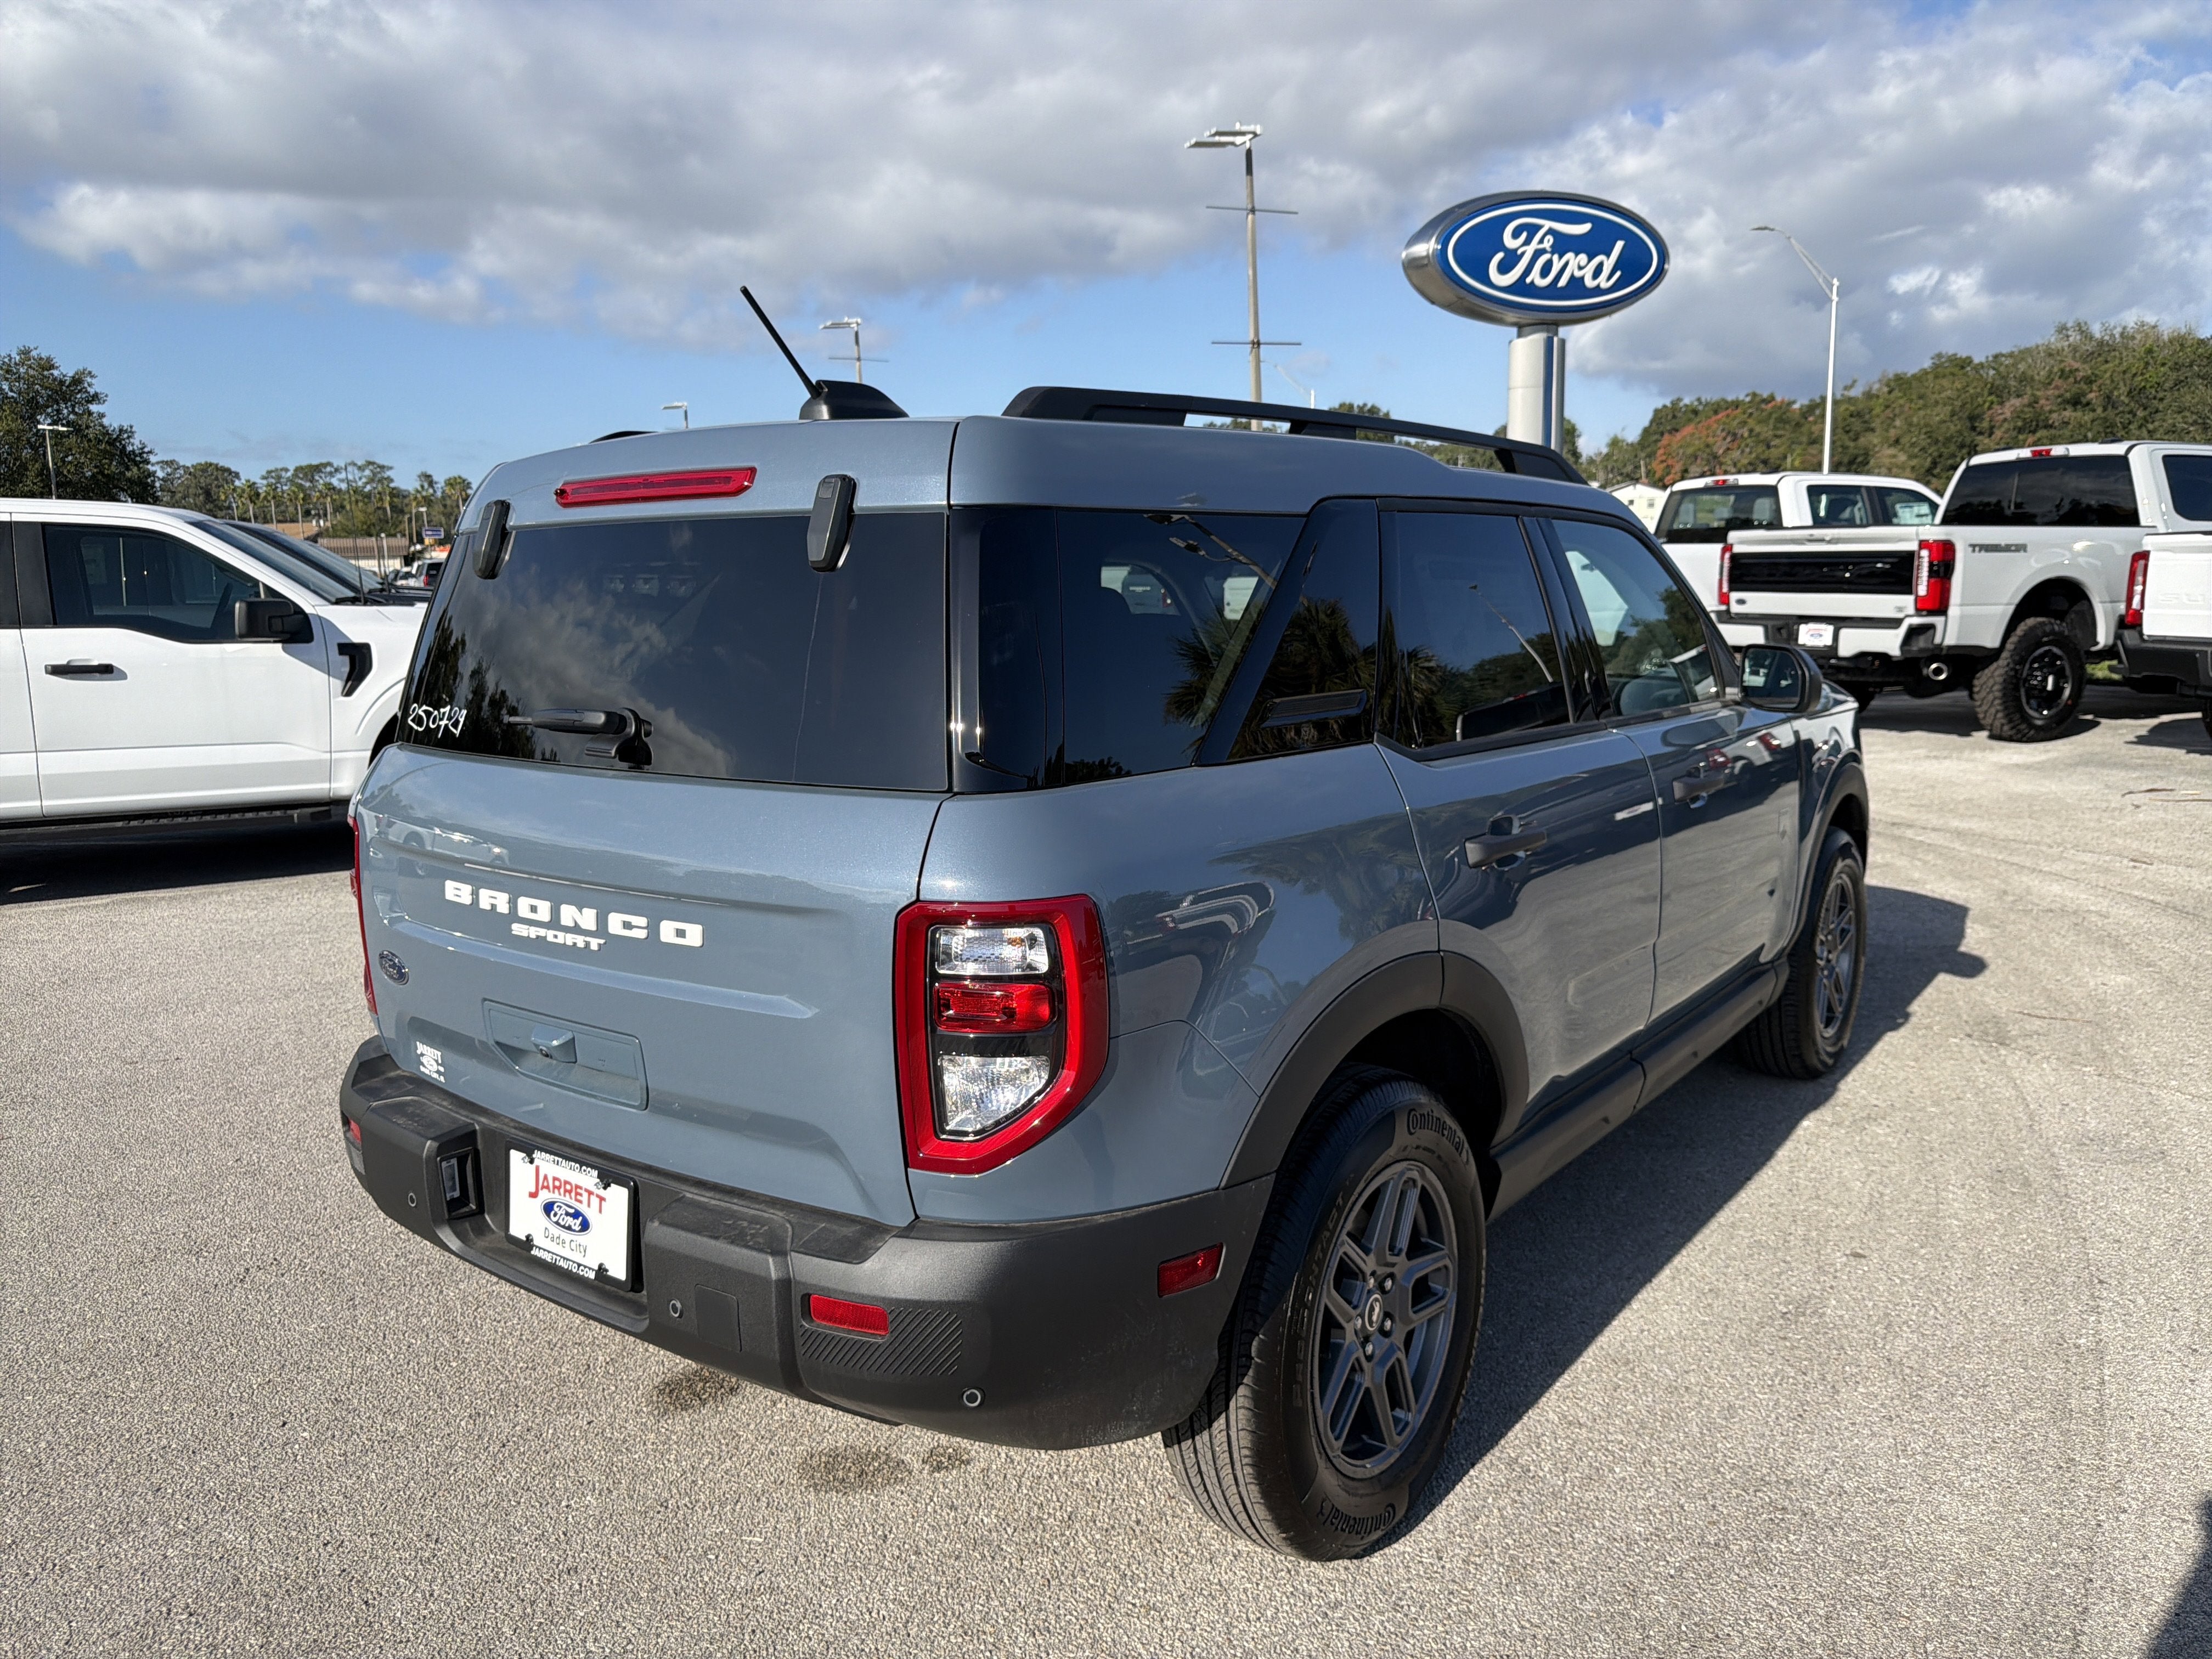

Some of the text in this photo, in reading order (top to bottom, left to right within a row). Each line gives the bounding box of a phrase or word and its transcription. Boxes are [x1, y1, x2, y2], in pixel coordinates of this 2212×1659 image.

[1488, 217, 1626, 289] Ford
[445, 879, 704, 947] BRONCO
[511, 923, 606, 951] SPORT
[1407, 1108, 1464, 1157] Continental
[532, 1149, 599, 1178] JARRETTAUTO.COM
[528, 1165, 606, 1215] JARRETT
[550, 1202, 583, 1231] Ford
[544, 1227, 588, 1258] Dade City
[531, 1246, 596, 1280] JARRETTAUTO.COM
